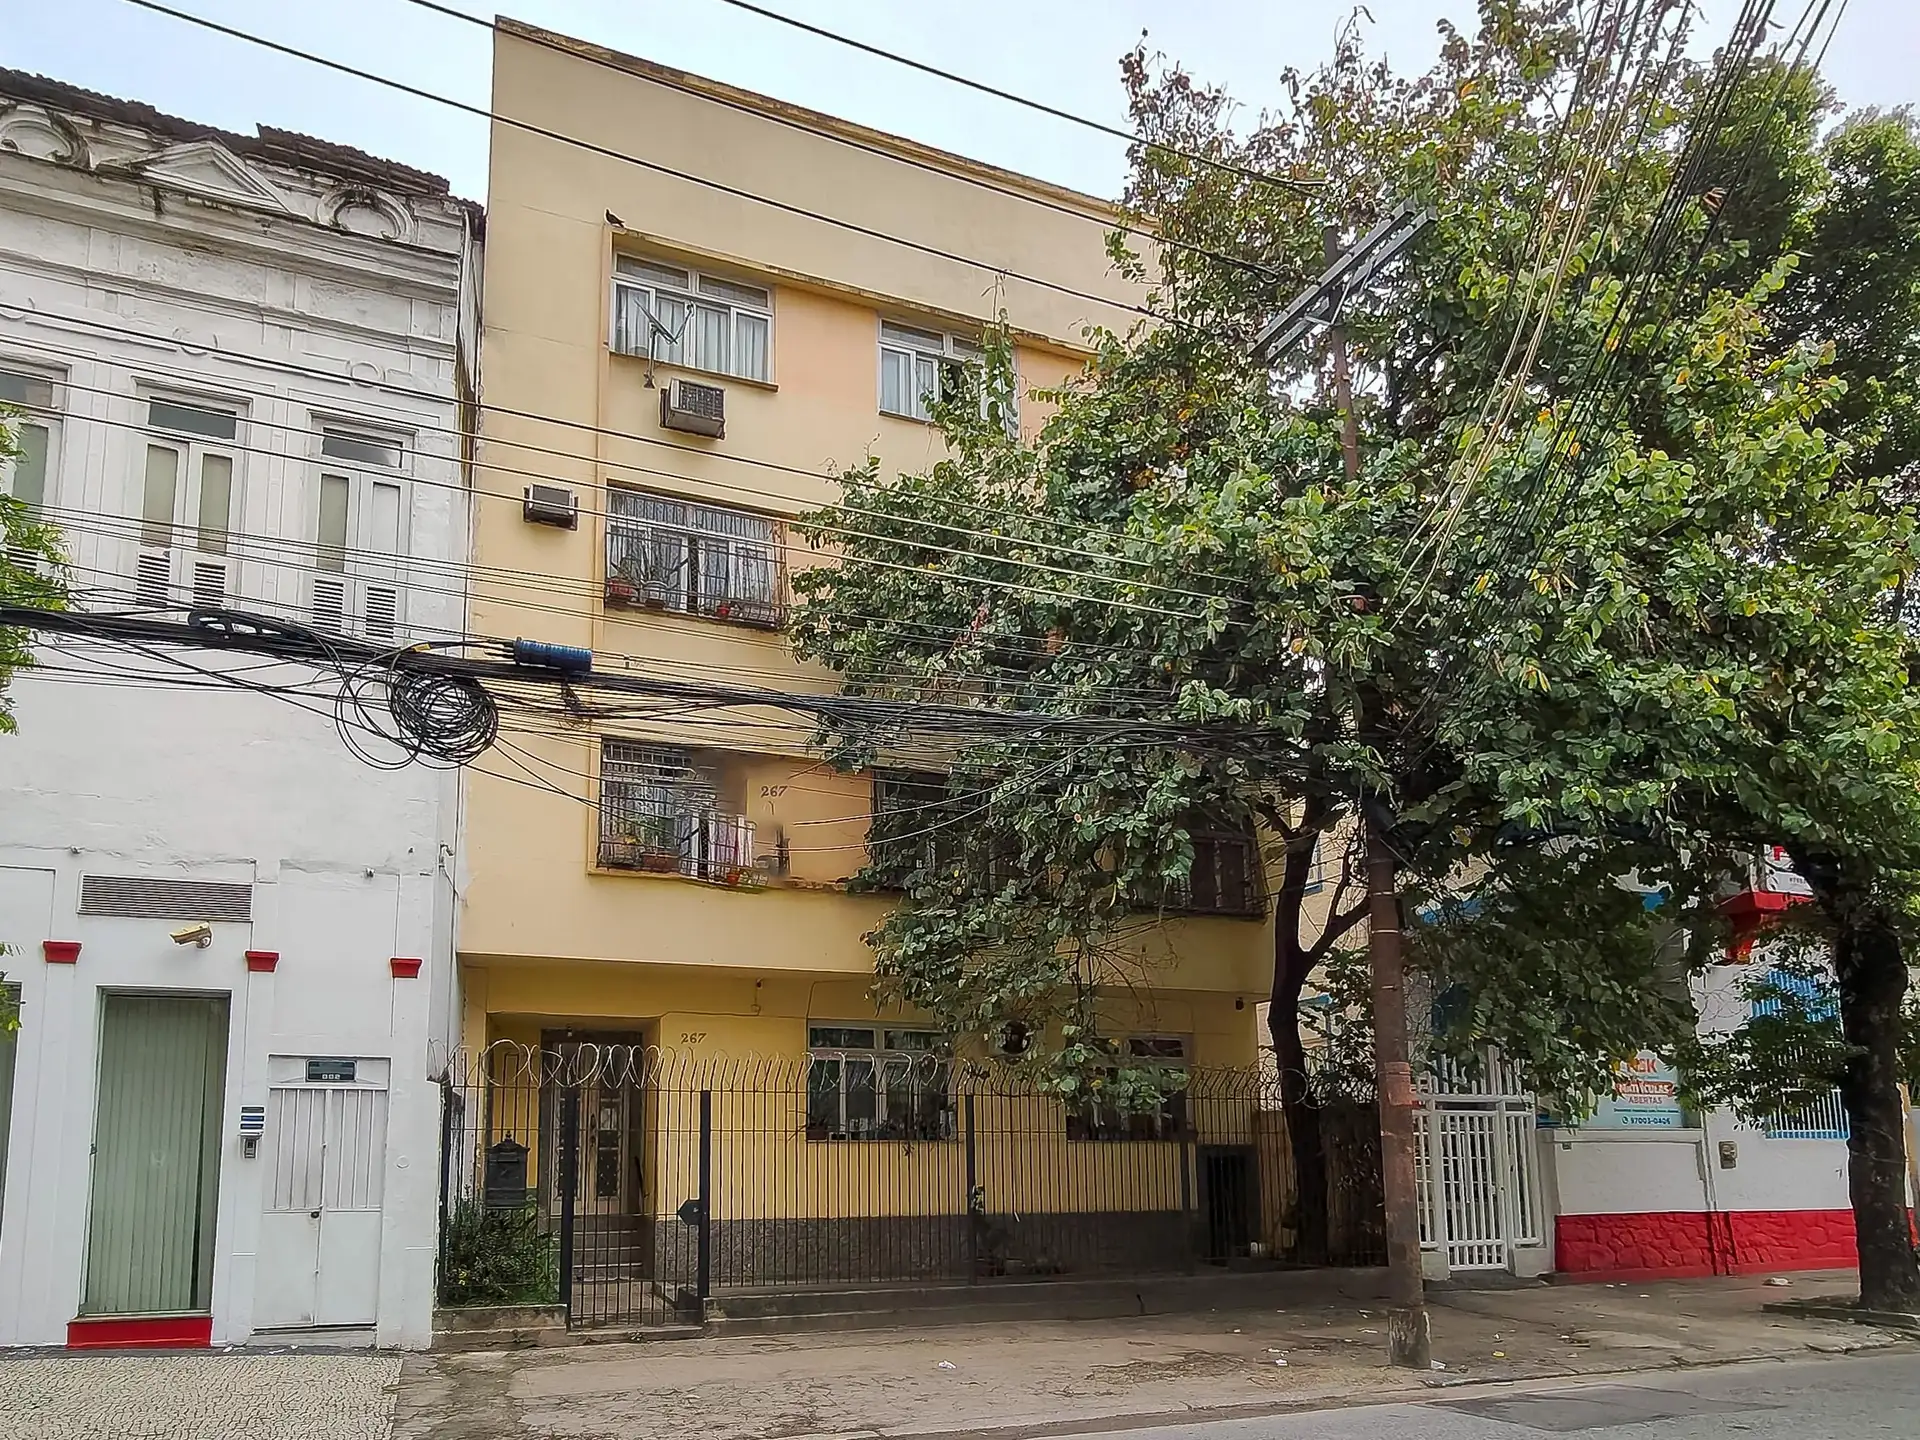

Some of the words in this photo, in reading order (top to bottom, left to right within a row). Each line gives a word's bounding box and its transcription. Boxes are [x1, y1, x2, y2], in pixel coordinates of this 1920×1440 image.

[760, 785, 788, 798] 267
[680, 1032, 707, 1045] 267
[1628, 1096, 1663, 1105] ABERTAS
